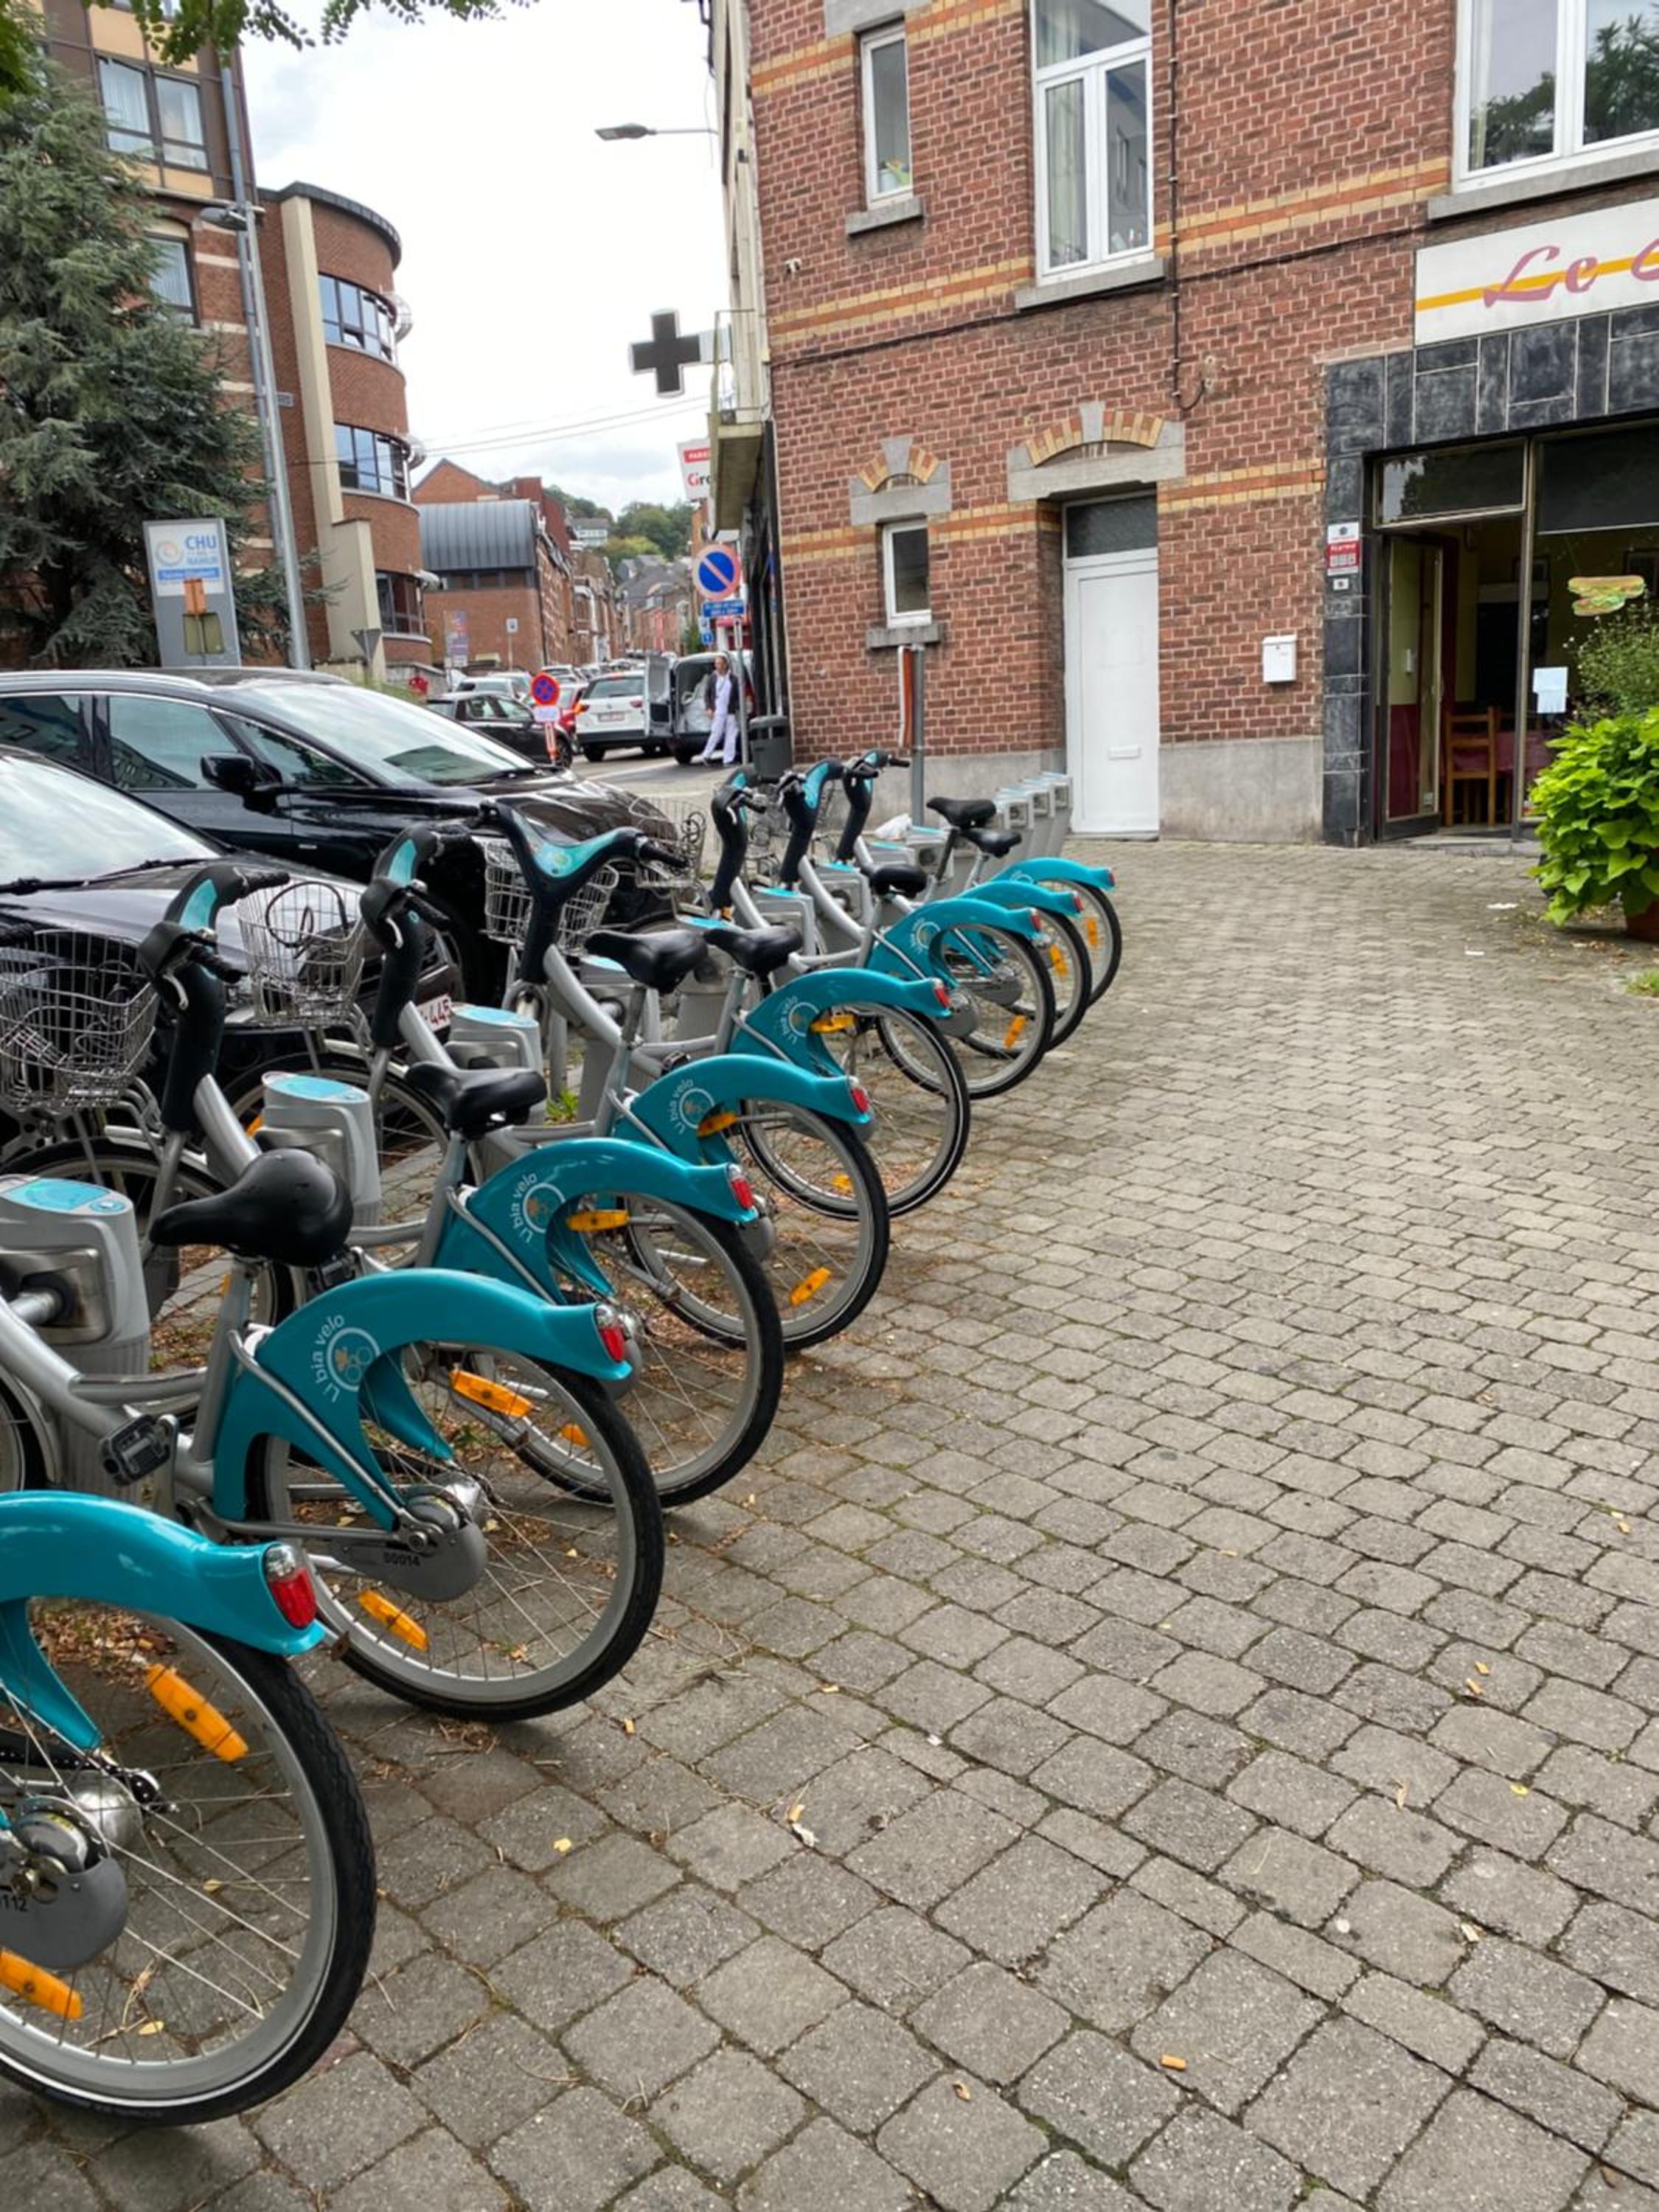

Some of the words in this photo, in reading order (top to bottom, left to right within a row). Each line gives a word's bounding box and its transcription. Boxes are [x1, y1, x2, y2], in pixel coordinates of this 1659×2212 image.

[1484, 246, 1599, 308] Le
[184, 535, 217, 549] CHU
[512, 1173, 538, 1198] velo
[509, 1203, 524, 1229] bia
[518, 1227, 534, 1244] Li
[314, 1315, 345, 1345] velo
[310, 1350, 328, 1384] bia
[322, 1382, 340, 1402] Li
